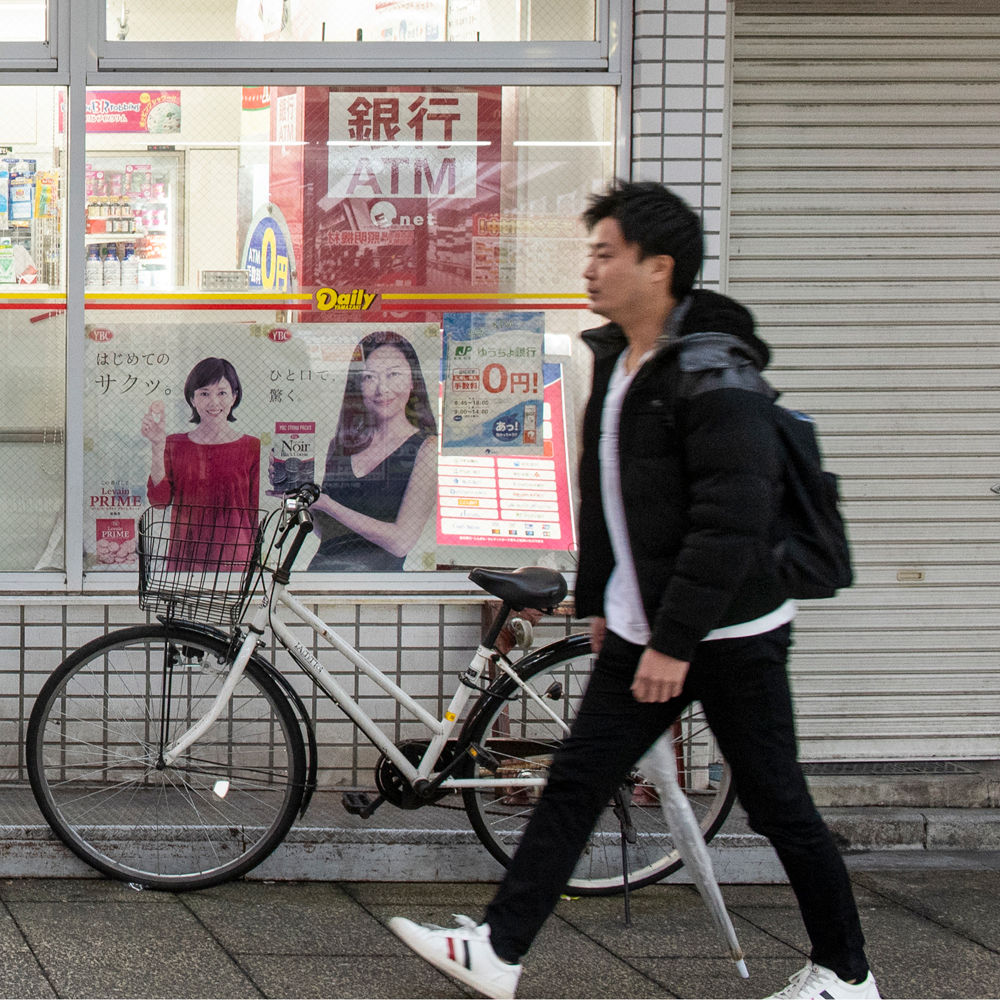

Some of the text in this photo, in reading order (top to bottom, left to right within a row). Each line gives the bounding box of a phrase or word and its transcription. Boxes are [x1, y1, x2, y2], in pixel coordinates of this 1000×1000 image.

[347, 95, 461, 150] 銀行
[345, 157, 457, 195] ATM
[316, 287, 378, 311] Daily
[93, 330, 110, 341] YBC
[272, 330, 289, 341] YBC
[477, 346, 537, 358] ゆうちょ銀行
[96, 352, 170, 366] はじめての
[95, 374, 172, 396] サクッ。
[495, 420, 519, 432] あっ!
[101, 487, 130, 495] Levain
[90, 495, 142, 507] PRIME
[102, 530, 130, 538] PRIME
